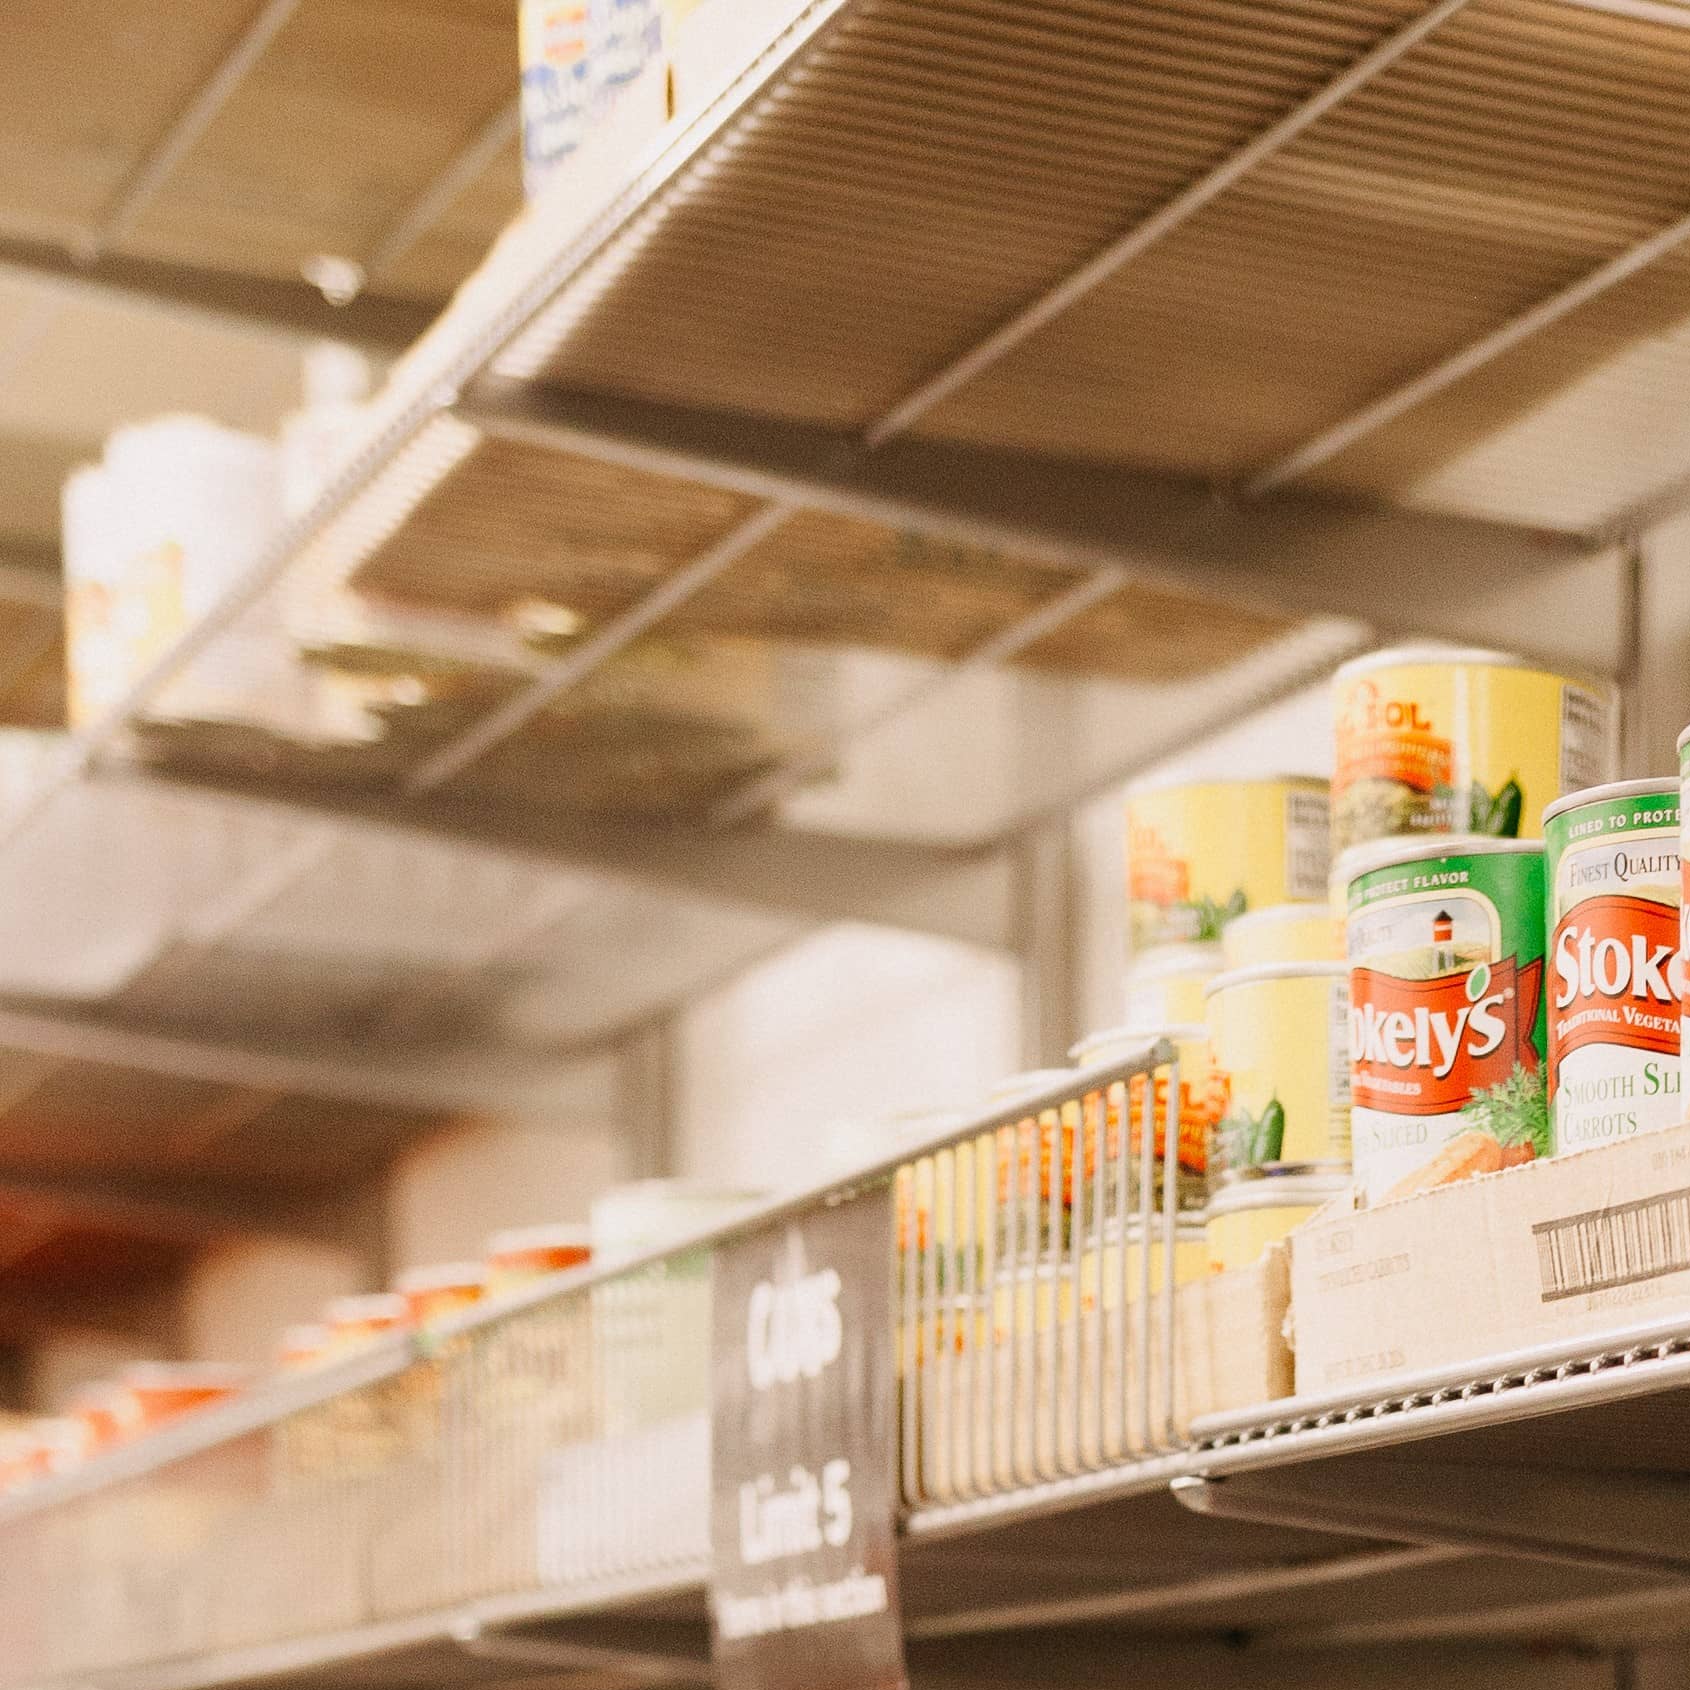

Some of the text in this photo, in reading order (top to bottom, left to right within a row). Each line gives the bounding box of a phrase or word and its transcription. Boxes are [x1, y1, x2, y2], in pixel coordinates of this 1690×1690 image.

[1608, 815, 1627, 829] TO
[1412, 870, 1470, 890] FLAVOR
[1570, 859, 1610, 888] FINEST
[1563, 1110, 1638, 1146] CARROTS
